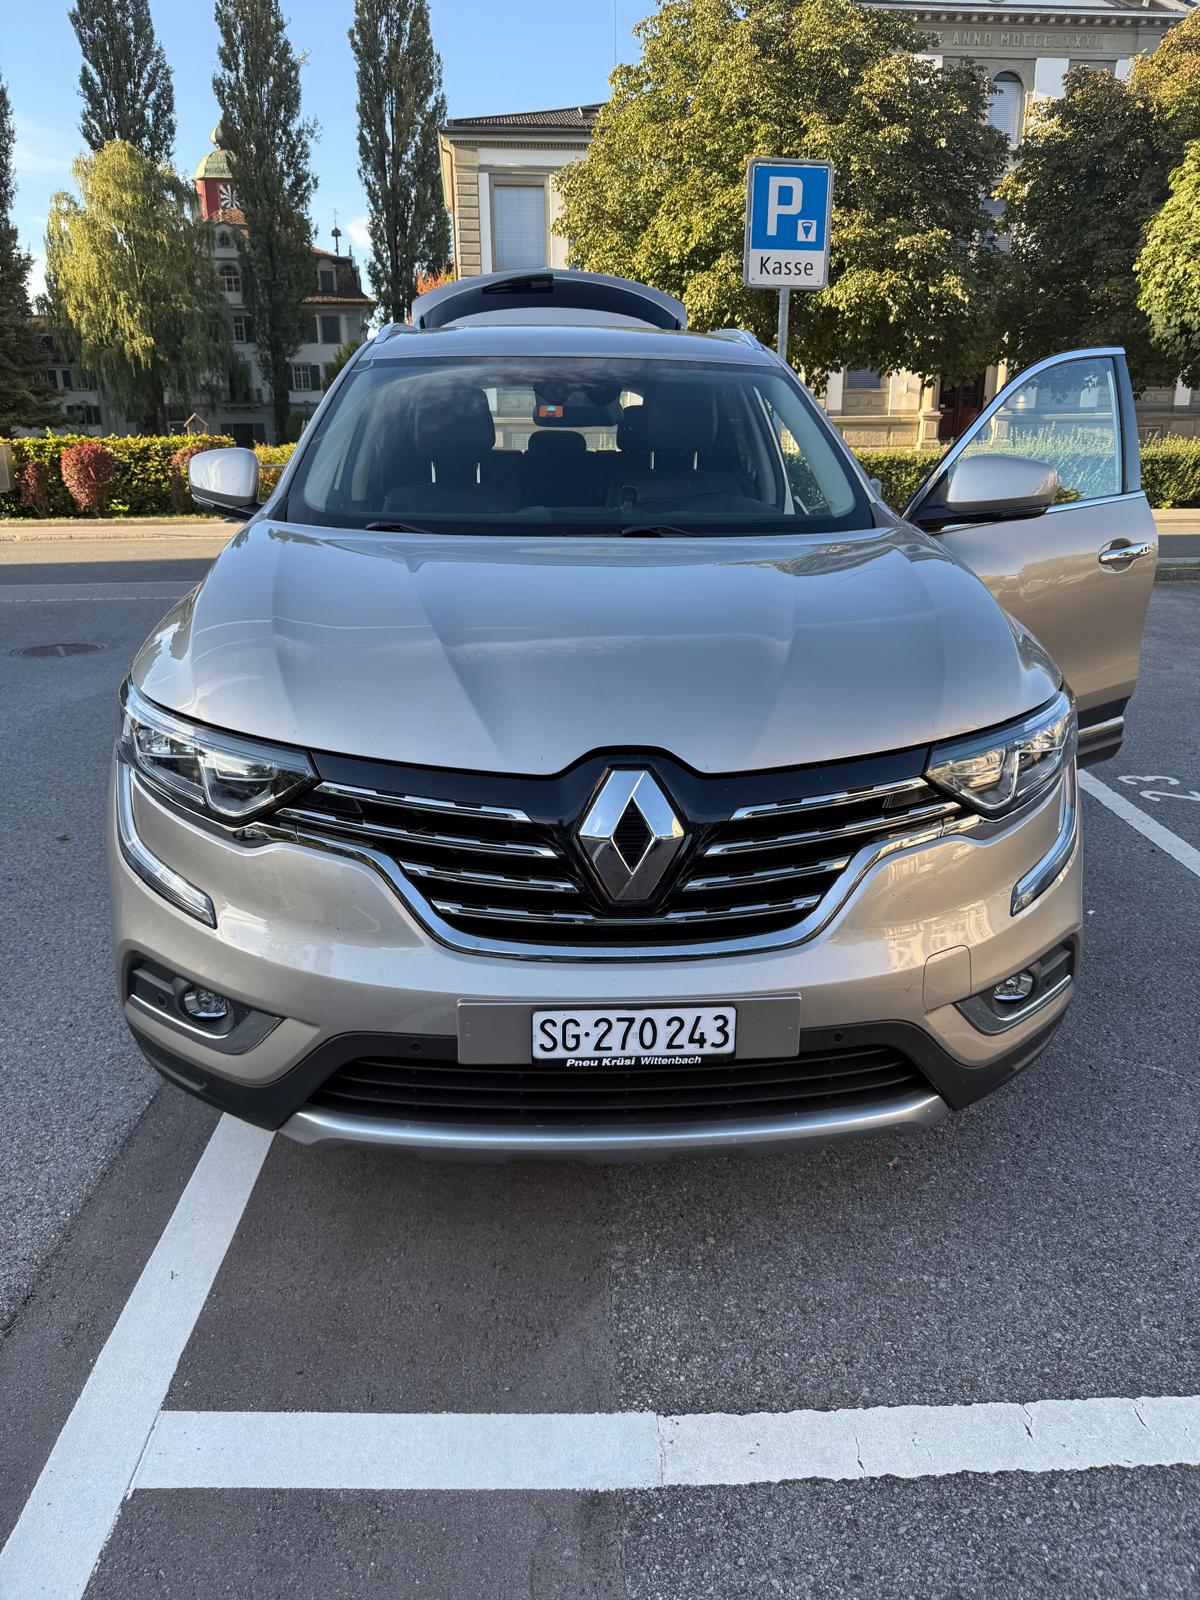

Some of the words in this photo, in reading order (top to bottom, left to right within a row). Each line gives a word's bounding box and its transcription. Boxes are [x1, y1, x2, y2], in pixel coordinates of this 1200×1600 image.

[952, 31, 992, 46] ANNO
[766, 176, 803, 236] P
[760, 256, 814, 276] Kasse
[566, 1058, 598, 1067] Pneu
[602, 1056, 635, 1067] Krüsi
[641, 1055, 702, 1066] Wittenbach
